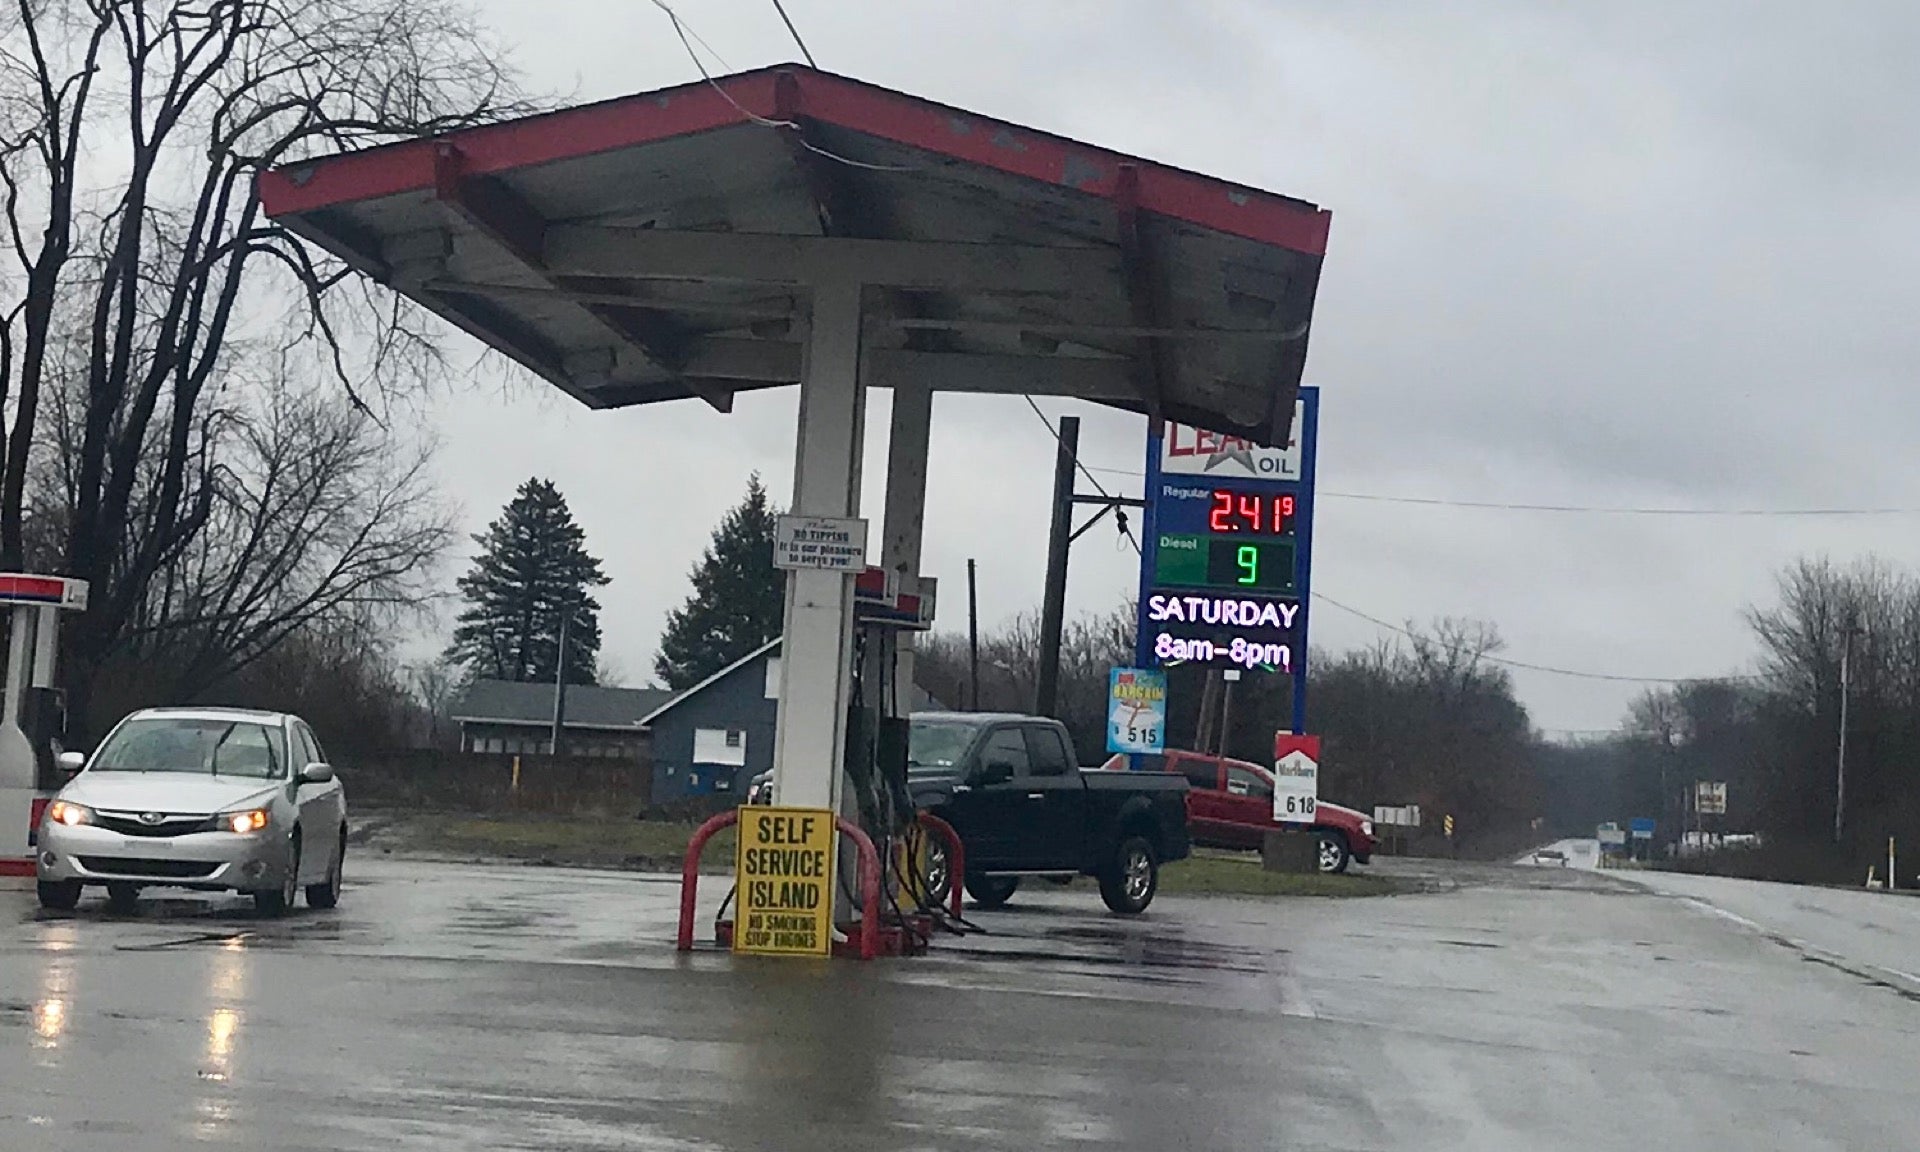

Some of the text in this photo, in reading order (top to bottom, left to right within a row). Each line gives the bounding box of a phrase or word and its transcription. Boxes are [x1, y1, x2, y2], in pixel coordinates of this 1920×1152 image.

[1169, 421, 1296, 457] LEA
[1259, 457, 1294, 474] OIL
[1162, 485, 1210, 499] Regular
[793, 529, 849, 542] NO TIPPING
[1159, 536, 1197, 550] Diesel
[1237, 546, 1258, 584] 9
[1148, 595, 1299, 629] SATURDAY
[1154, 632, 1291, 669] 8am-8pm
[757, 816, 815, 844] SELF
[745, 848, 825, 877] SERVICE
[747, 880, 819, 909] ISLAND
[749, 914, 817, 932] NO SMOKING
[745, 931, 771, 946] STOP
